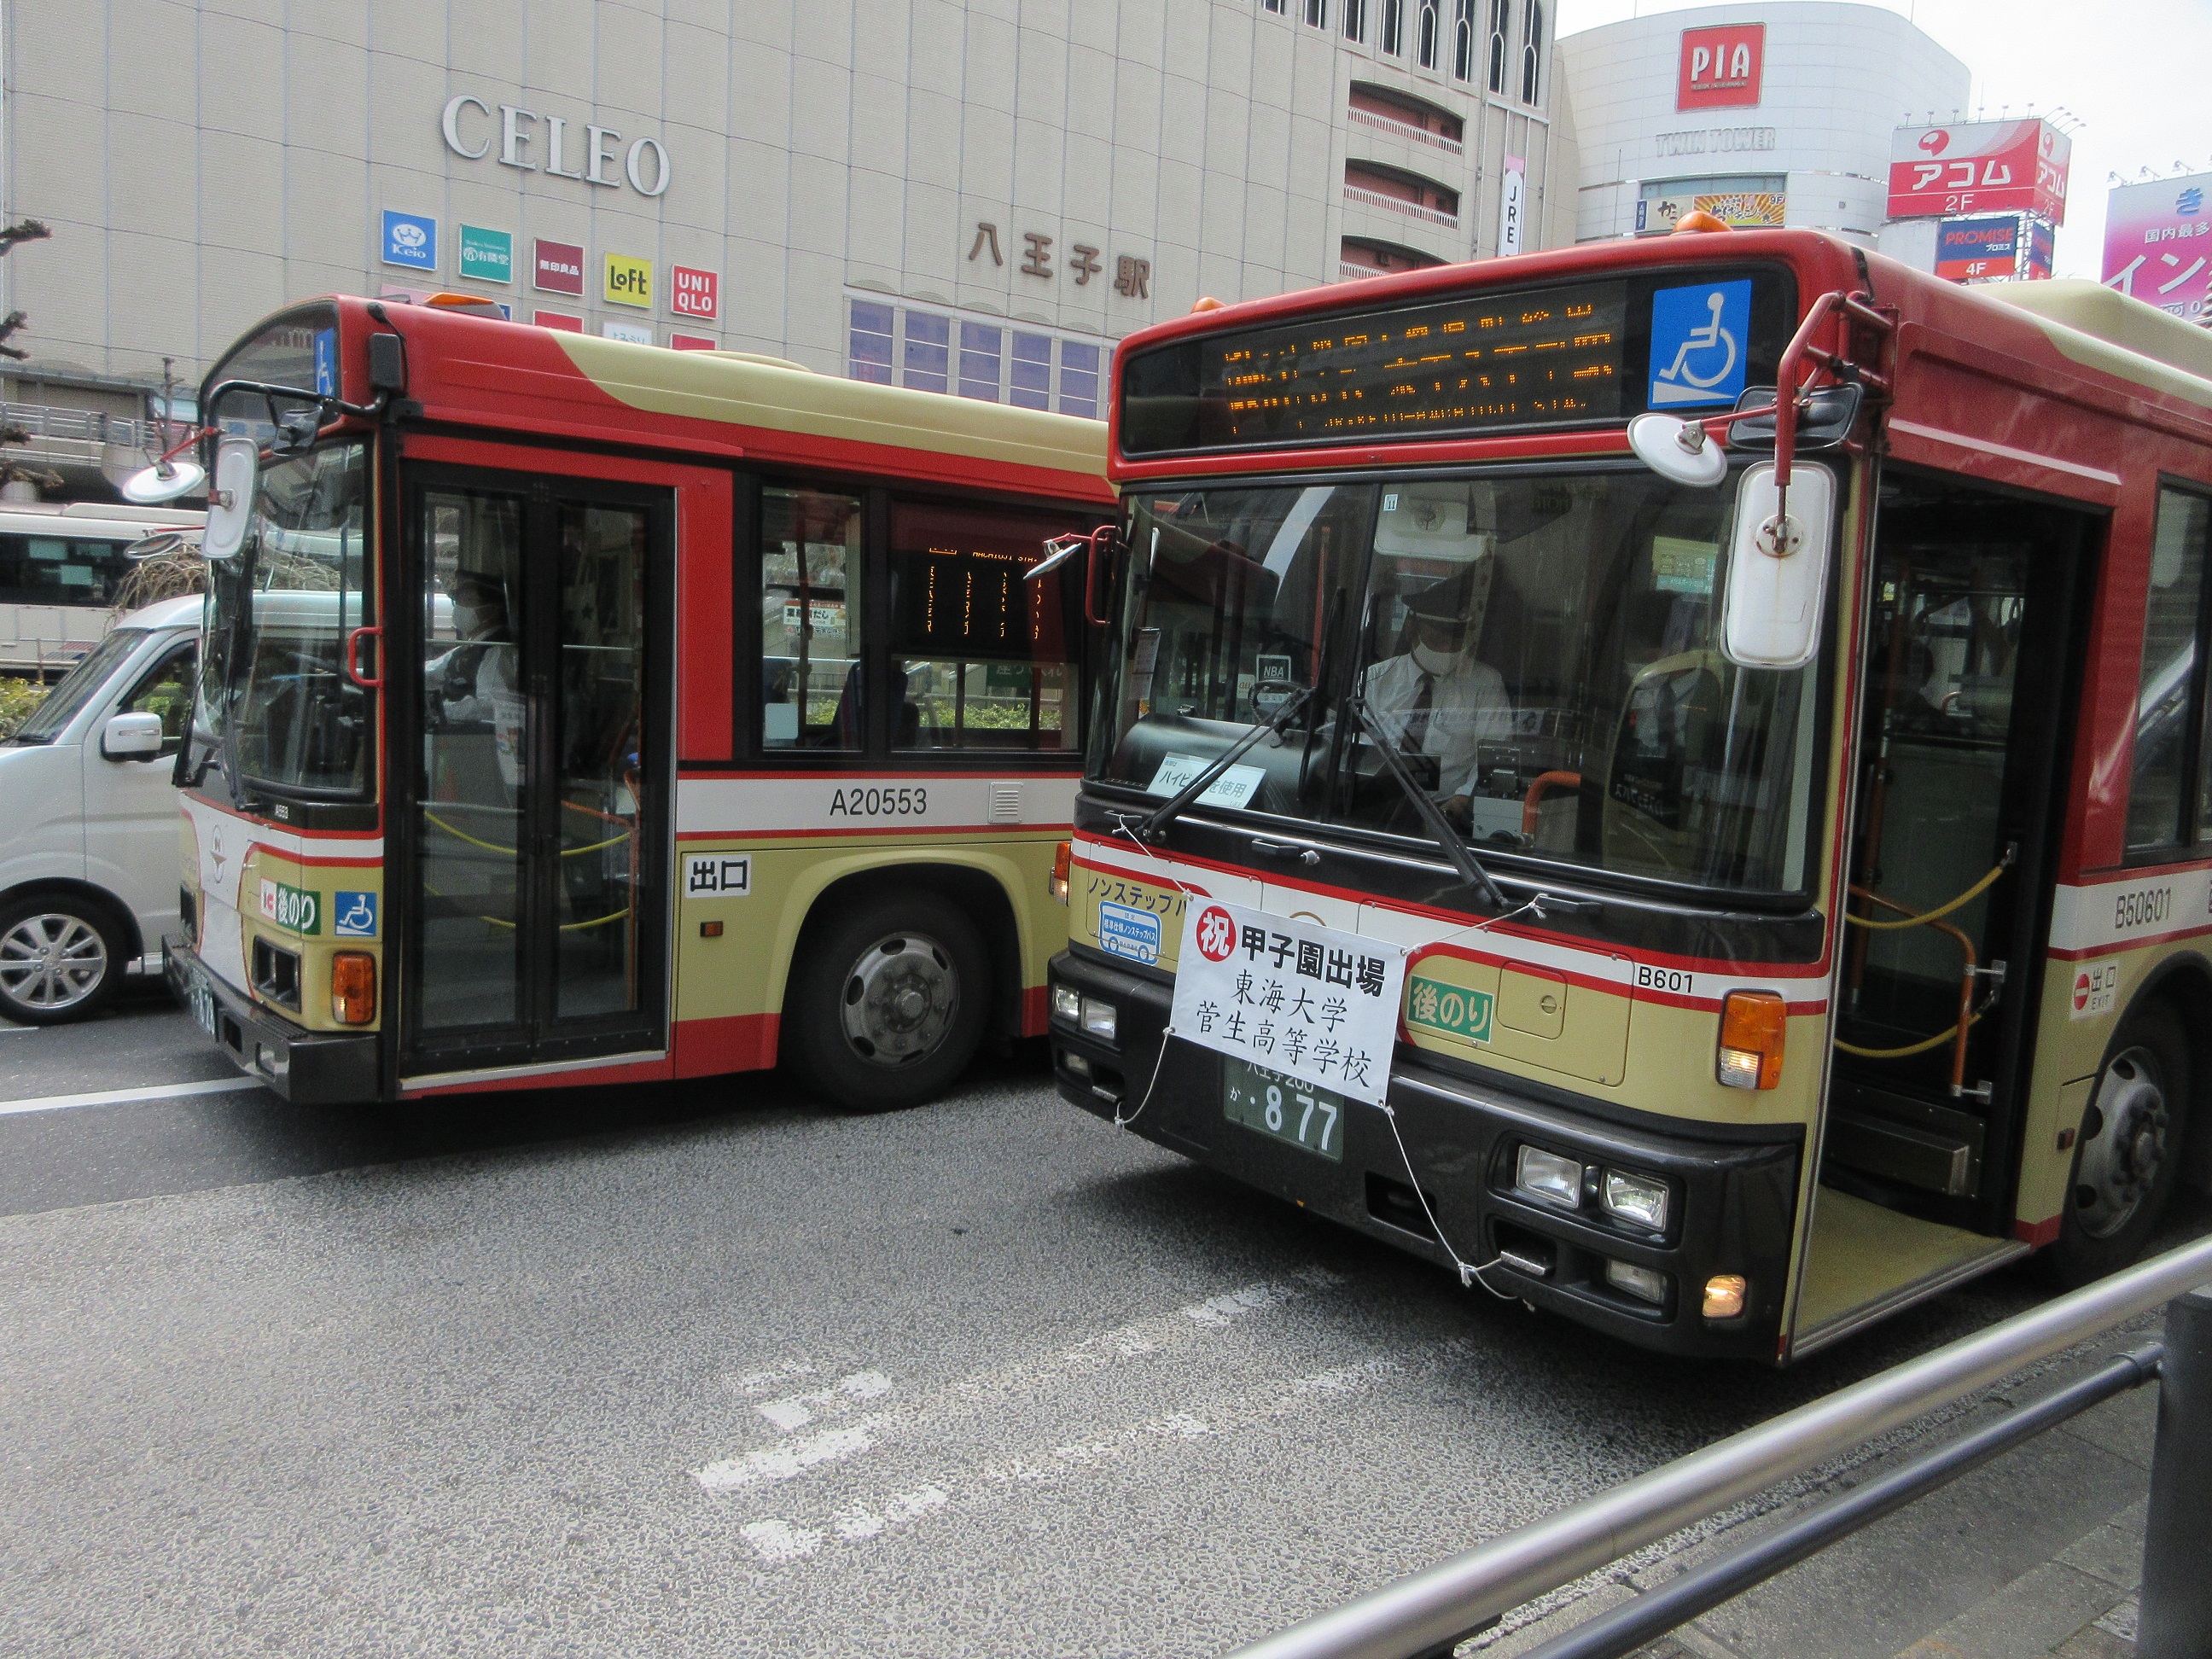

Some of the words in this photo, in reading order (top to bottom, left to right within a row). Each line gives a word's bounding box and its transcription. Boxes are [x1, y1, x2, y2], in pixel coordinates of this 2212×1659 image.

[1691, 43, 1750, 82] PIA
[442, 94, 672, 197] CELEO
[1656, 130, 1706, 157] TWIN
[1708, 127, 1776, 153] TOWER
[1912, 160, 2011, 191] アコム
[2036, 161, 2065, 199] アコム
[1945, 194, 1974, 212] 2F
[392, 243, 427, 259] Keio
[1944, 228, 2015, 247] PROMISE
[1985, 243, 2011, 253] プロミス
[539, 259, 580, 276] 無印良品
[969, 222, 1151, 300] 八王子駅
[1965, 262, 1988, 276] 4F
[678, 272, 710, 294] UNI
[678, 292, 713, 312] QLO
[1263, 666, 1284, 678] NBA
[1159, 770, 1248, 798] ハイビを使用
[829, 788, 928, 817] A20553
[690, 859, 748, 893] 出口
[277, 888, 317, 929] 後のり
[2115, 886, 2172, 929] B50601
[1200, 911, 1231, 957] 祝
[1241, 924, 1386, 998] 甲子園出場
[1638, 966, 1694, 994] B601
[2091, 965, 2116, 992] 出口
[1231, 969, 1348, 1033] 東海大学
[1412, 981, 1489, 1033] 後のり
[2091, 994, 2110, 1010] EXIT
[1196, 1000, 1372, 1088] 菅生高等学校
